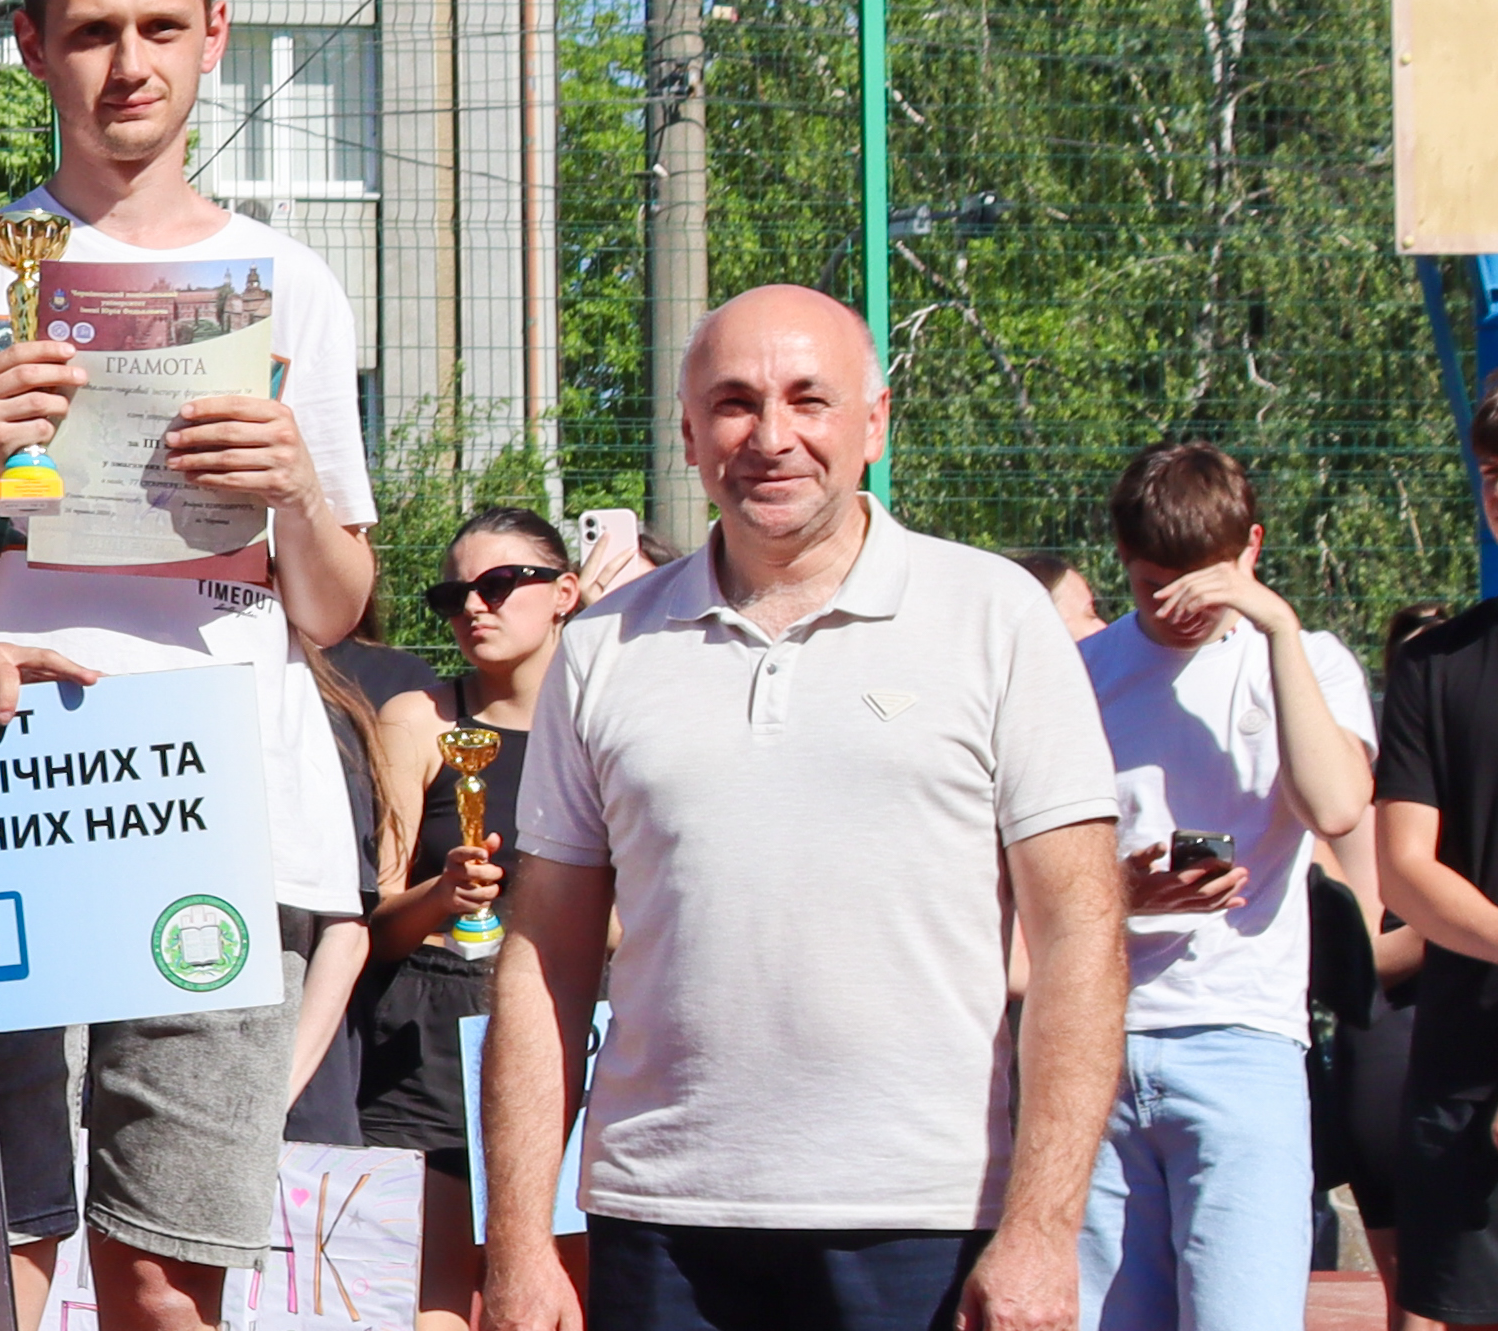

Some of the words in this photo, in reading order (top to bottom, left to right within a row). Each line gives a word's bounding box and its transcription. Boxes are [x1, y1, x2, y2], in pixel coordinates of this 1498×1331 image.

[106, 357, 207, 376] ГРАМОТА
[196, 579, 274, 614] TIMEOUT
[151, 741, 206, 778] ТА
[85, 797, 207, 841] НАУК
